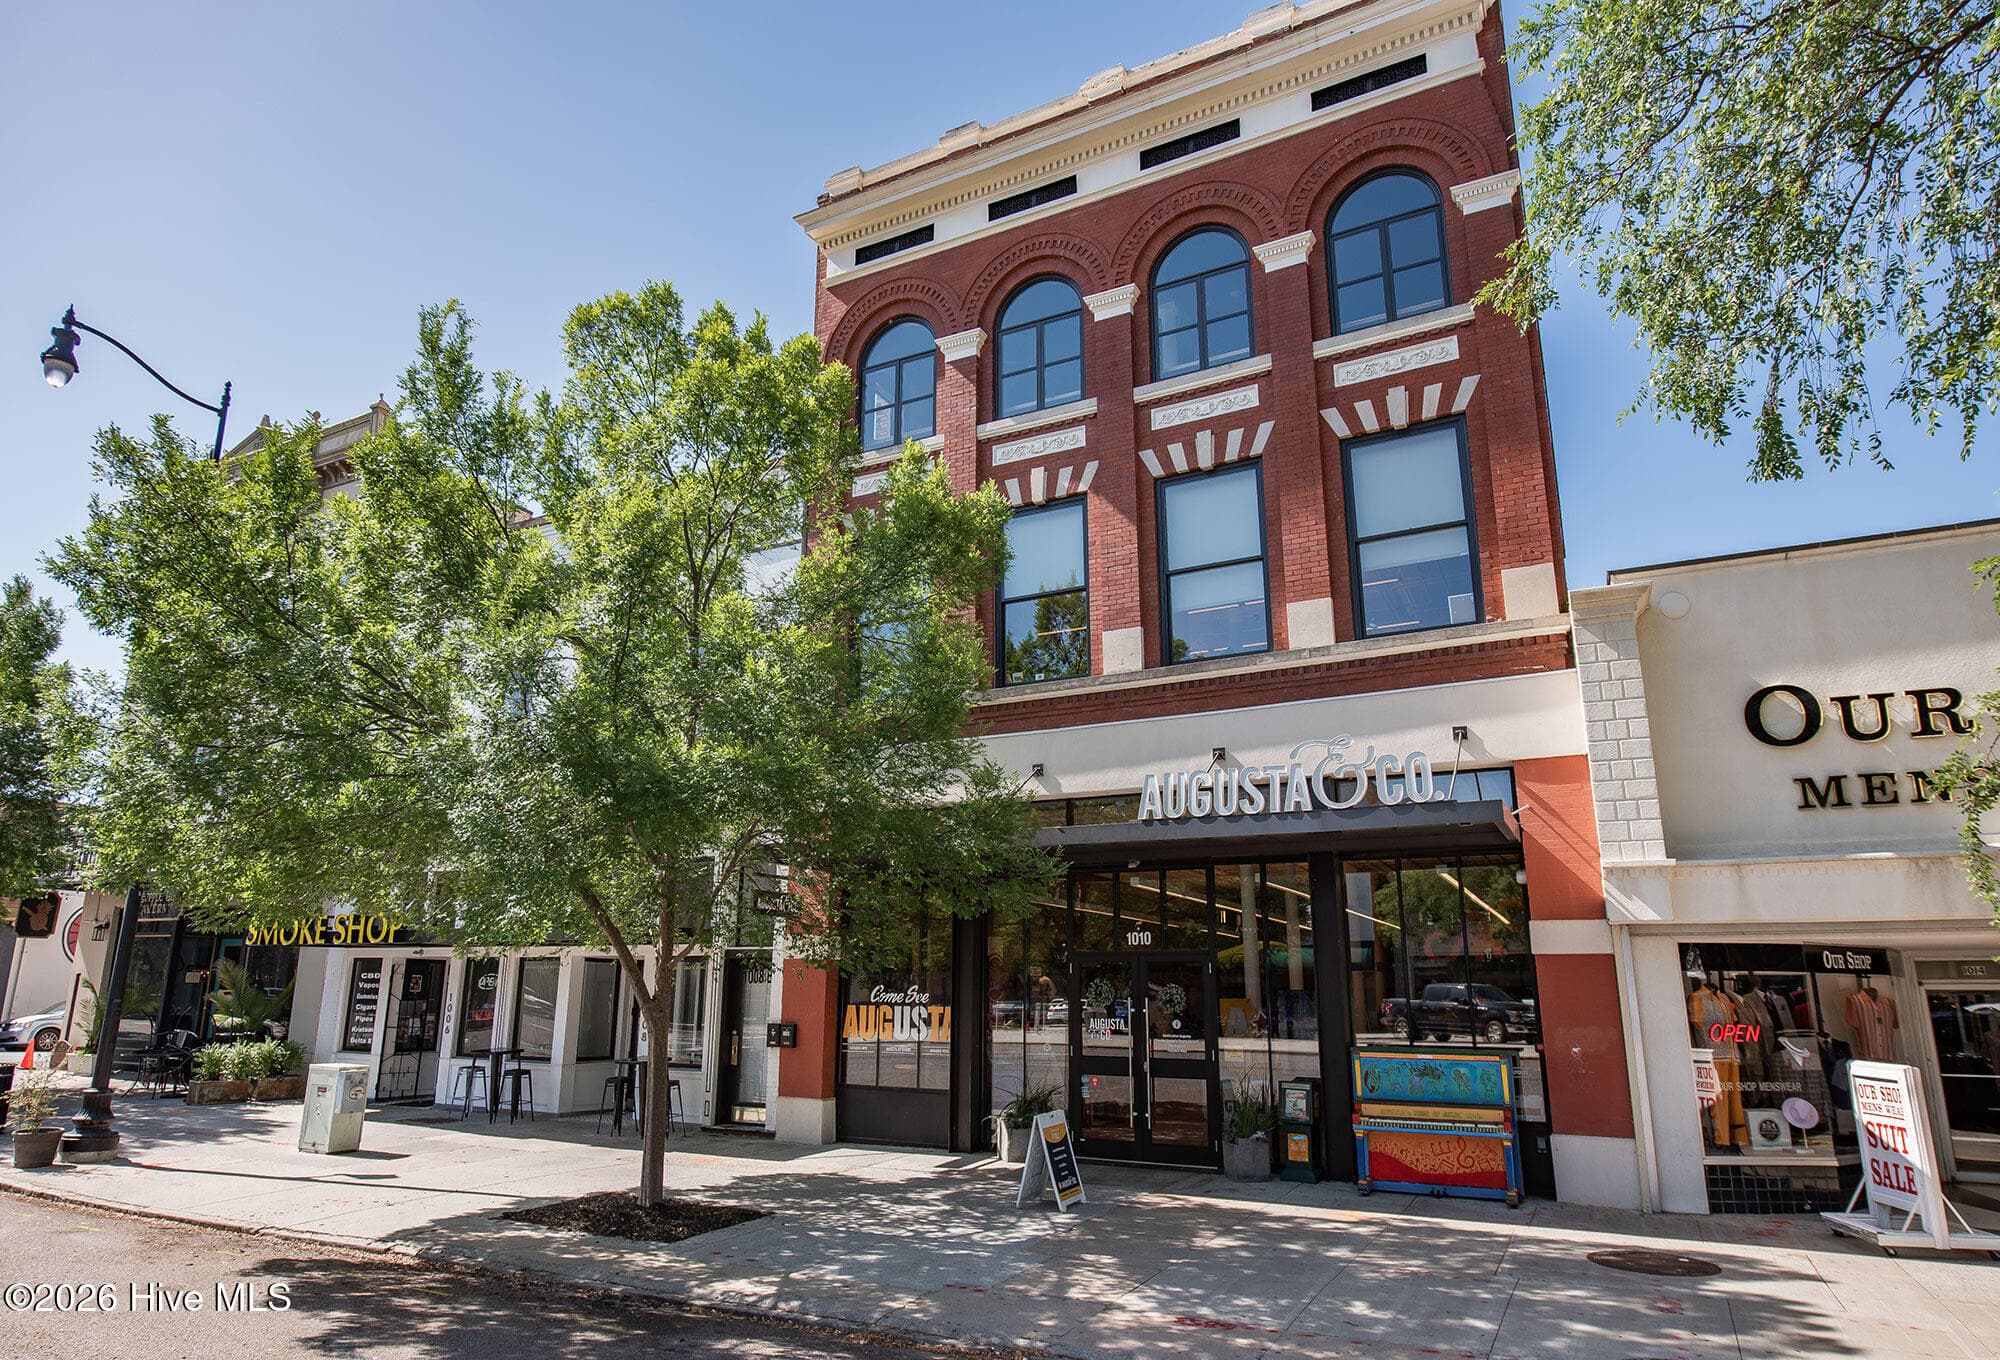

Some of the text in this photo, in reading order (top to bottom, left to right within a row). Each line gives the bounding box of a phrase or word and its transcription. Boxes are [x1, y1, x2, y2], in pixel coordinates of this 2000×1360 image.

[1744, 684, 1977, 748] OUR
[1137, 762, 1313, 821] AUGUSTA
[1375, 751, 1446, 806] CO.
[1793, 766, 1998, 812] MEN
[245, 912, 404, 946] SMOKE SHOP
[1126, 931, 1151, 946] 1010
[1823, 950, 1872, 969] OUR SHOP
[1962, 966, 1986, 976] 1014
[870, 984, 930, 1004] Come See
[355, 1003, 377, 1011] Cigars
[444, 993, 453, 1034] 1006
[355, 1015, 374, 1023] Pipes
[842, 1004, 952, 1041] AUGUSTA
[1089, 1017, 1126, 1030] AUGUSTA
[1709, 1023, 1761, 1043] OPEN
[1736, 1082, 1758, 1091] SHOP
[1759, 1082, 1803, 1092] MENSWEAR
[1858, 1083, 1877, 1100] OUR
[1861, 1101, 1882, 1112] MENS
[1865, 1121, 1909, 1155] SUIT
[1870, 1157, 1918, 1196] SALE
